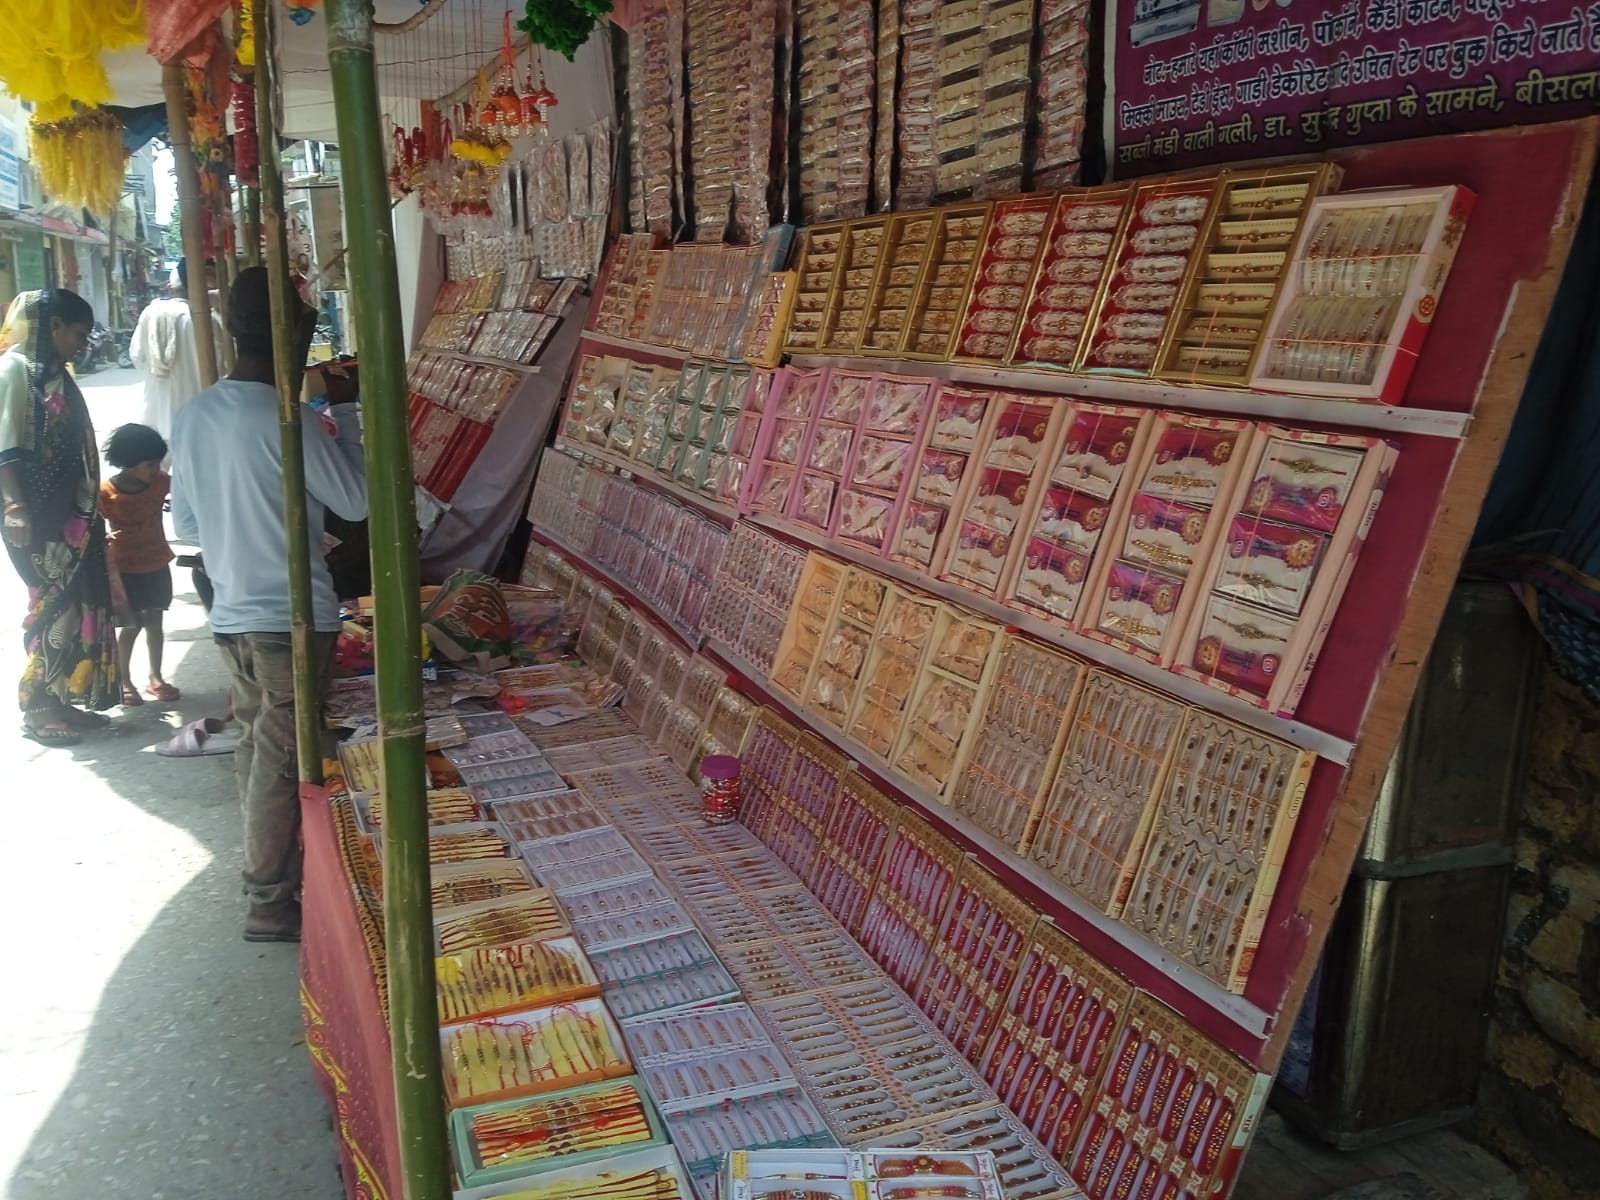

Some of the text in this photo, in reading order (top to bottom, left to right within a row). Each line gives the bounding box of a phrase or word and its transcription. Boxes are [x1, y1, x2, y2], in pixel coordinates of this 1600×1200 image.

[1235, 66, 1269, 107] गाड़ी
[1352, 45, 1395, 84] उचित
[1397, 38, 1423, 77] रेट
[1424, 41, 1451, 73] पर
[1449, 35, 1488, 79] बुक
[1491, 16, 1537, 64] किये
[1539, 6, 1586, 55] जाते
[1257, 18, 1309, 56] मशीन,
[1152, 127, 1180, 158] मंडी
[1183, 120, 1215, 152] वाली
[1345, 98, 1392, 136] गुप्ता
[1397, 83, 1420, 119] के
[1424, 74, 1505, 114] सामने,
